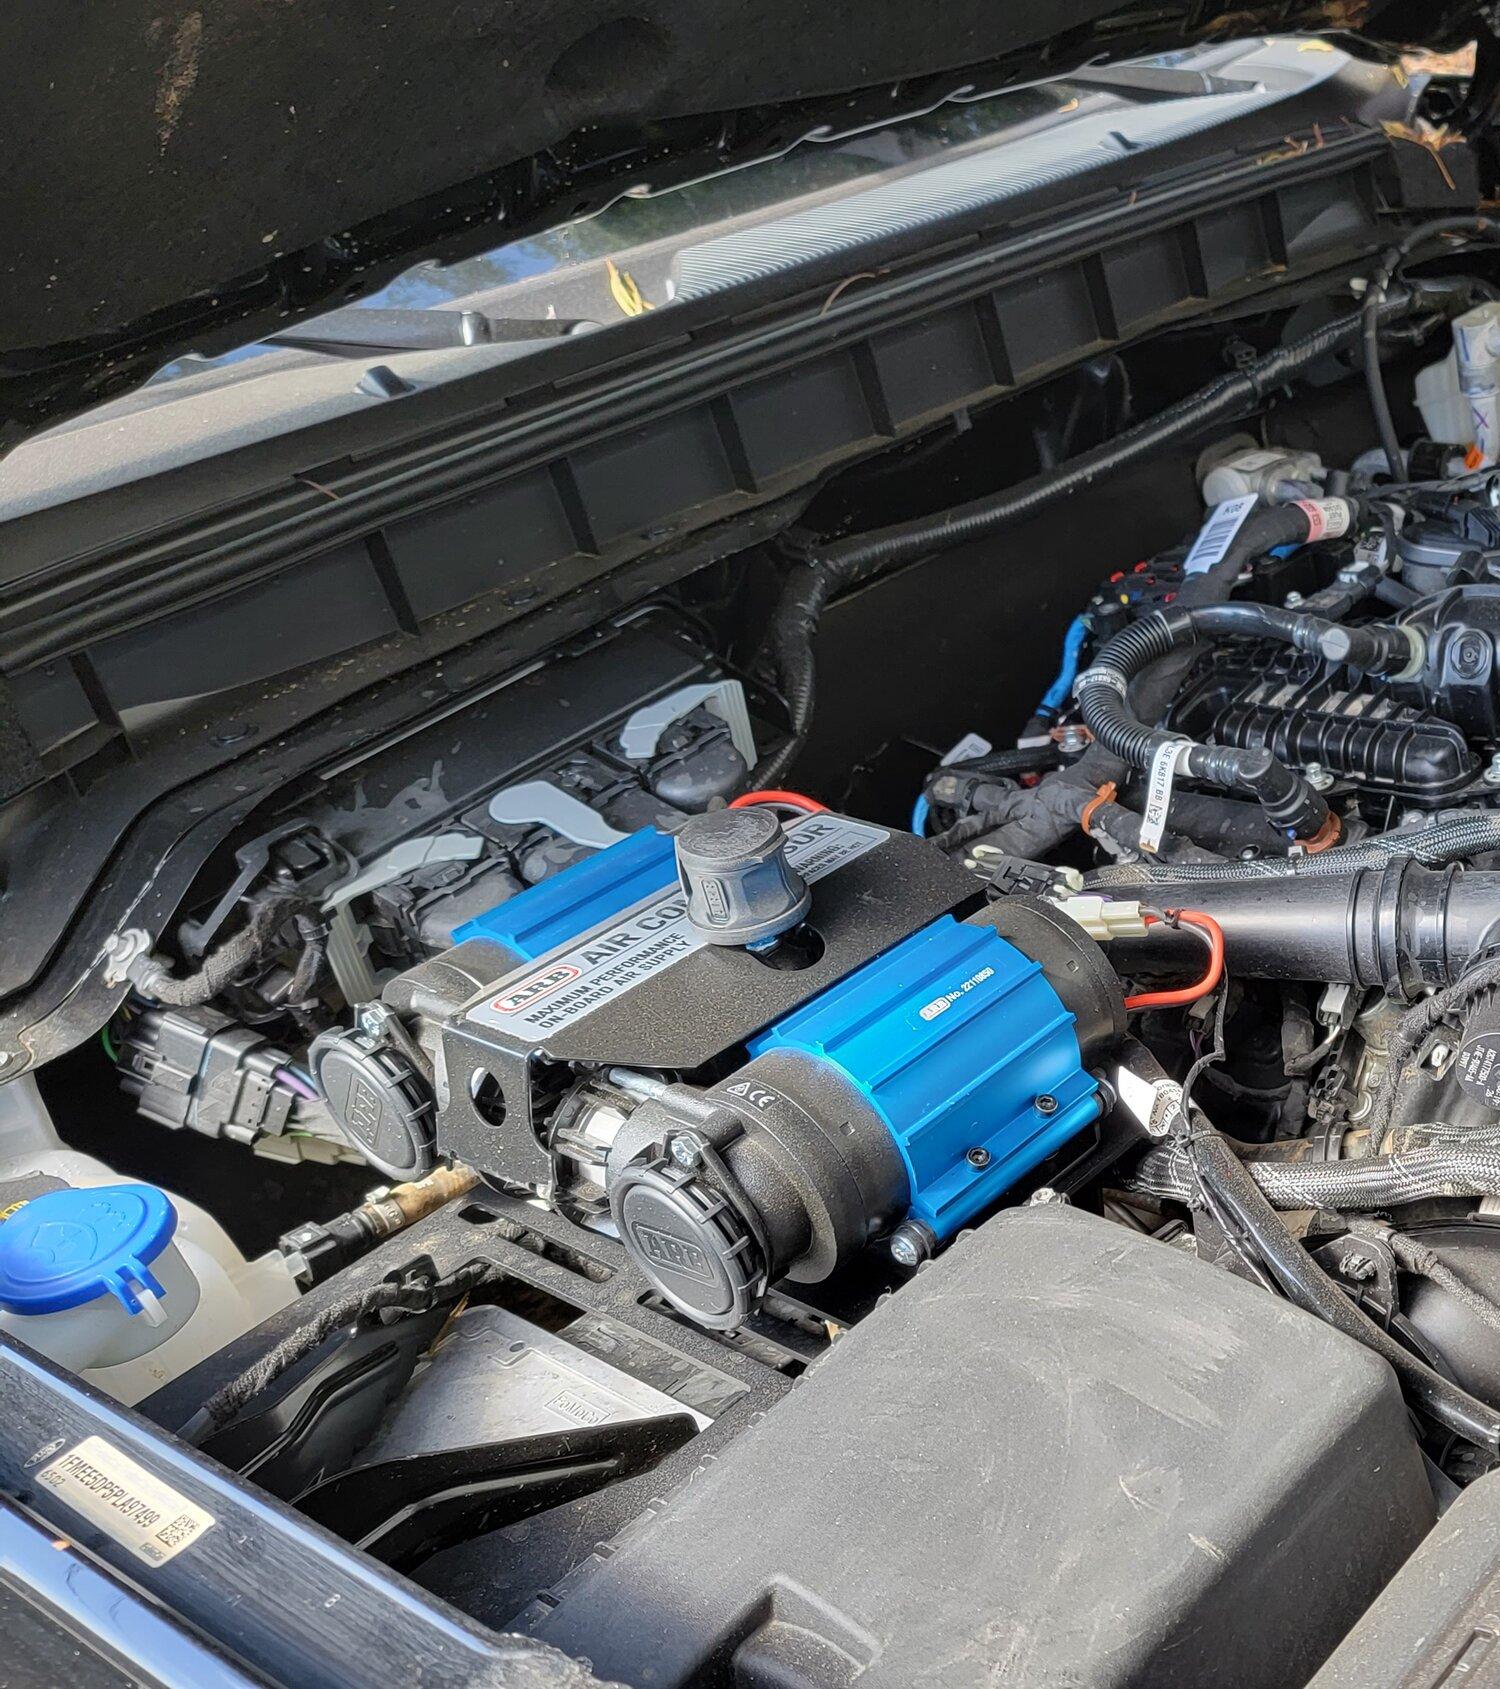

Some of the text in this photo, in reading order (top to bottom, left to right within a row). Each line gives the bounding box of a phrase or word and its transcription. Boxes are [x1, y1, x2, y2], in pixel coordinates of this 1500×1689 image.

[507, 971, 571, 1007] ARB
[580, 932, 642, 965] AIR
[524, 933, 685, 1024] MAXIMUM PERFORMANCE
[538, 940, 692, 1029] ON-BOARD AIR SUPPLY
[945, 991, 964, 1002] No.
[40, 1469, 66, 1488] 6502
[59, 1453, 162, 1528] 1FMEE5DP5PLA97499
